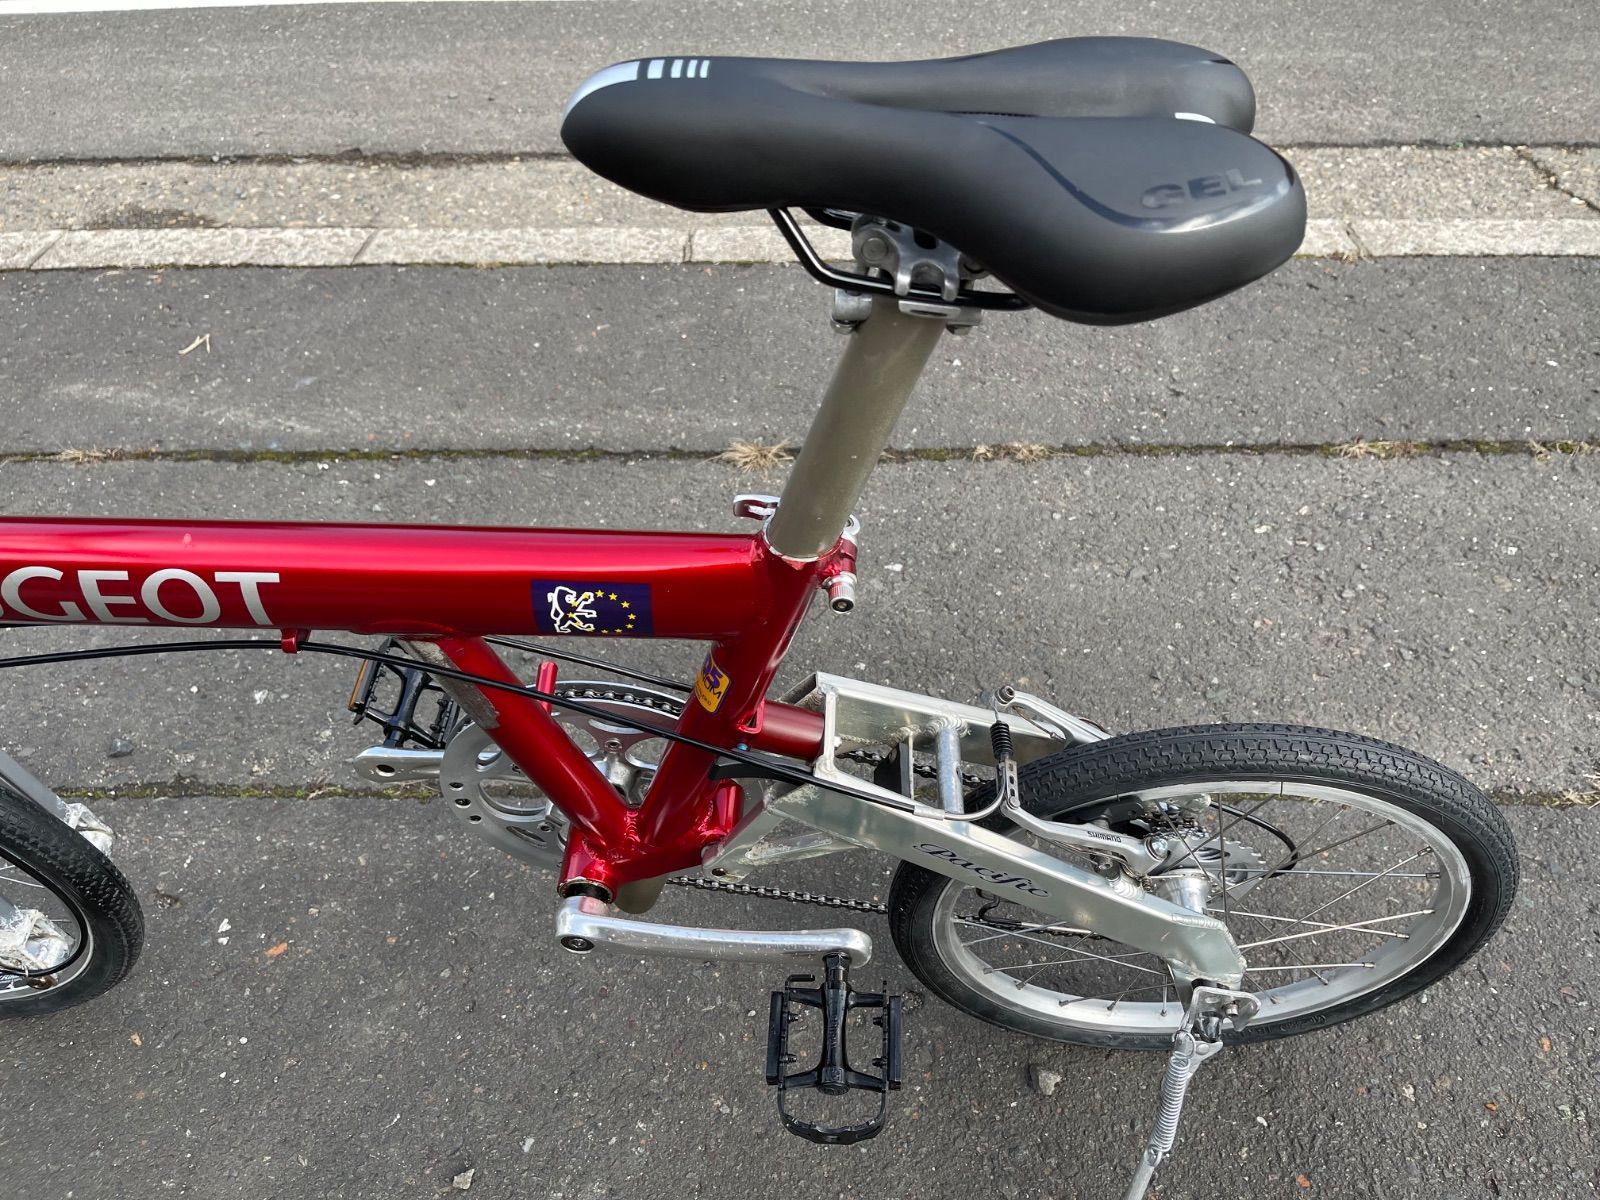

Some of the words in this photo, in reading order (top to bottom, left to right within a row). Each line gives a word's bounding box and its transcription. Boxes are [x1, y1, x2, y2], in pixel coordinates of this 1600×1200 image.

[1142, 169, 1263, 208] GEL
[0, 566, 280, 625] GEOT
[1088, 831, 1122, 843] SHIMANO
[913, 843, 1049, 898] Pacific
